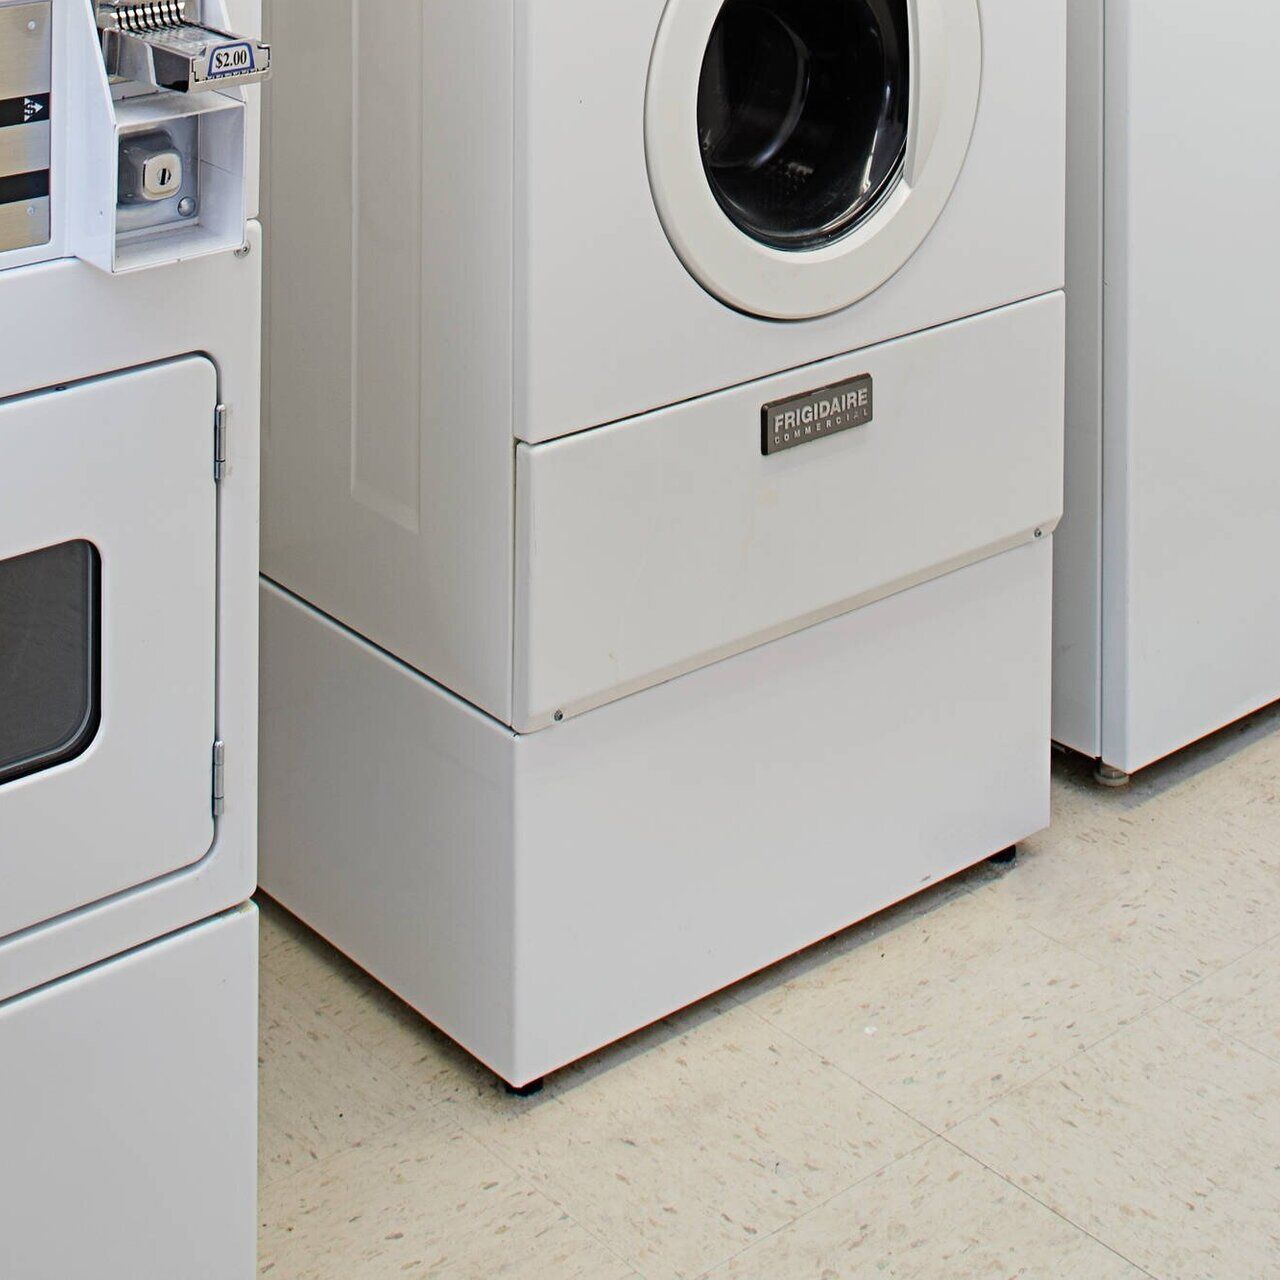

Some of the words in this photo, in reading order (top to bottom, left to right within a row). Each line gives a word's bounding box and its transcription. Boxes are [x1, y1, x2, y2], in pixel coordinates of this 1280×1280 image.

[215, 49, 247, 69] $2.00
[774, 387, 868, 433] FRIGIDAIRE
[774, 408, 868, 445] COMMERCIAL
